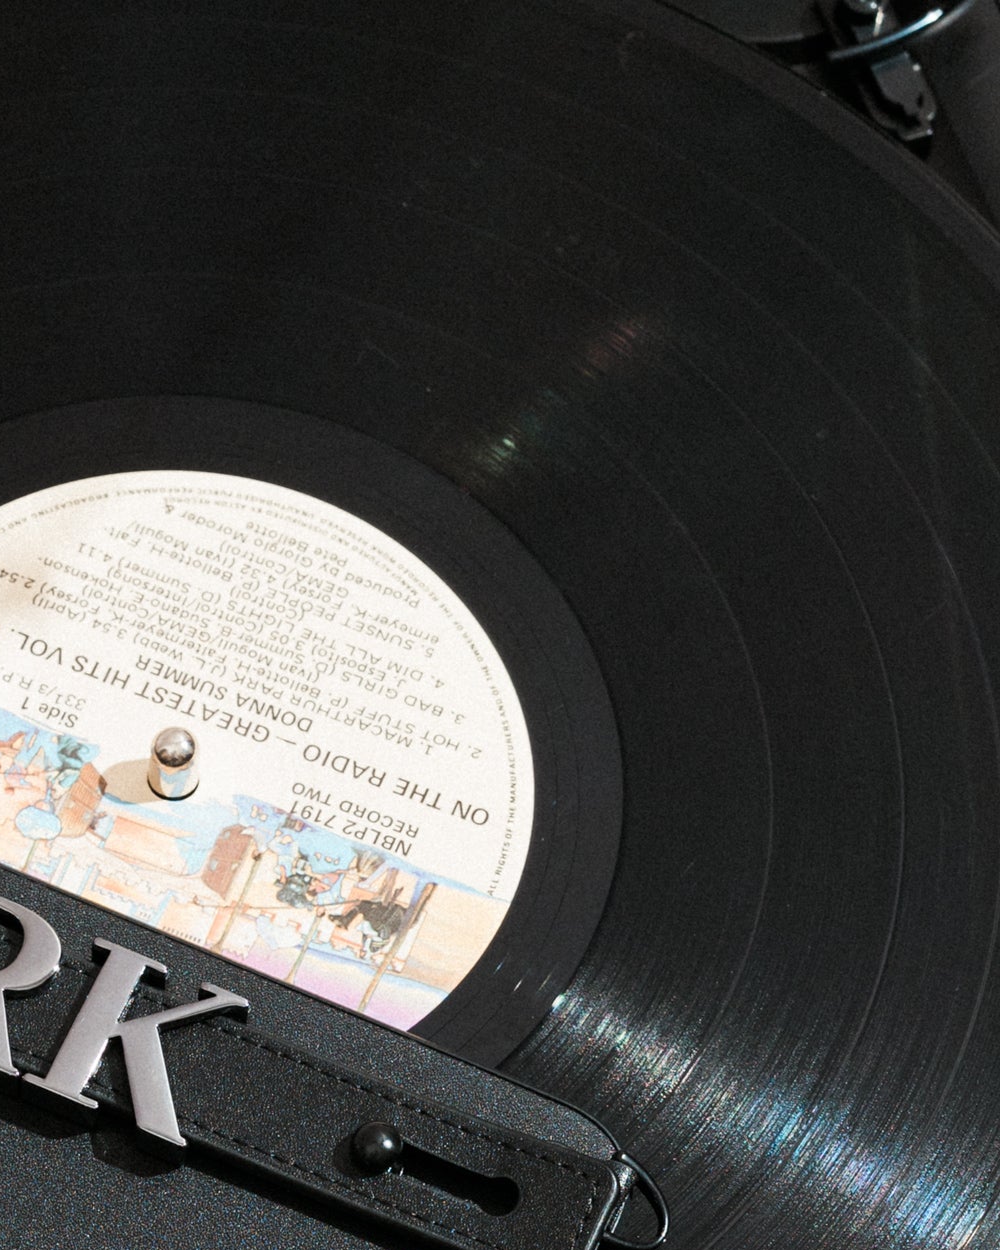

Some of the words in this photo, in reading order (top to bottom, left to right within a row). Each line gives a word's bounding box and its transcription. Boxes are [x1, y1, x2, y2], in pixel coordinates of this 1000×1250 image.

[165, 503, 175, 514] &
[181, 511, 248, 544] Moroder
[246, 521, 309, 553] Bellotte
[78, 542, 113, 562] 4.11
[195, 547, 236, 569] (Ivan
[253, 538, 313, 568] Giorgio
[313, 547, 348, 568] Pete
[0, 569, 36, 589] 2.54
[37, 556, 122, 594] Hokenson-
[117, 556, 192, 594] Summer)
[219, 540, 349, 599] GEMA/Control)
[240, 563, 277, 584] 4.32
[319, 562, 340, 577] by
[37, 581, 100, 615] Forsey)
[197, 588, 222, 605] (D.
[240, 577, 260, 592] (P.
[282, 579, 344, 610] Forsey)
[344, 572, 420, 609] Produced
[31, 593, 86, 620] (April)
[106, 566, 266, 635] (Control/Intersong)
[127, 591, 211, 629] Sudano-E.
[229, 585, 306, 622] (Control)
[265, 587, 336, 622] PEOPLE
[92, 619, 127, 639] 3.54
[227, 600, 295, 633] LIGHTS
[6, 628, 63, 665] VOL.
[133, 632, 183, 662] Webb)
[217, 623, 305, 665] Summer-B.
[269, 630, 305, 651] 3.05
[300, 628, 336, 650] THE
[342, 617, 415, 651] SUNSET
[311, 644, 387, 682] Esposito)
[346, 644, 382, 665] ALL
[421, 644, 435, 659] 5.
[71, 655, 131, 690] HITS
[135, 655, 228, 700] SUMMER
[189, 656, 227, 678] (J.L.
[279, 660, 321, 683] (Ivan
[312, 659, 336, 676] (D.
[387, 661, 424, 682] DIM
[233, 672, 284, 700] PARK
[341, 671, 398, 700] GIRLS
[394, 676, 407, 688] J.
[430, 676, 445, 689] 4.
[21, 697, 29, 710] 1
[134, 681, 270, 743] GREATEST
[235, 693, 313, 733] DONNA
[327, 693, 349, 709] (P.
[404, 695, 444, 717] BAD
[38, 703, 78, 728] Side
[290, 694, 413, 748] MACARTHUR
[353, 705, 416, 734] STUFF
[450, 711, 465, 725] 3.
[420, 730, 460, 751] HOT
[420, 742, 433, 755] 1.
[467, 745, 482, 759] 2.
[303, 744, 387, 788] RADIO
[292, 782, 331, 806] TWO
[393, 778, 442, 810] THE
[288, 800, 336, 829] 7191
[339, 800, 419, 838] RECORD
[451, 800, 489, 826] ON
[342, 820, 412, 857] NBLP2
